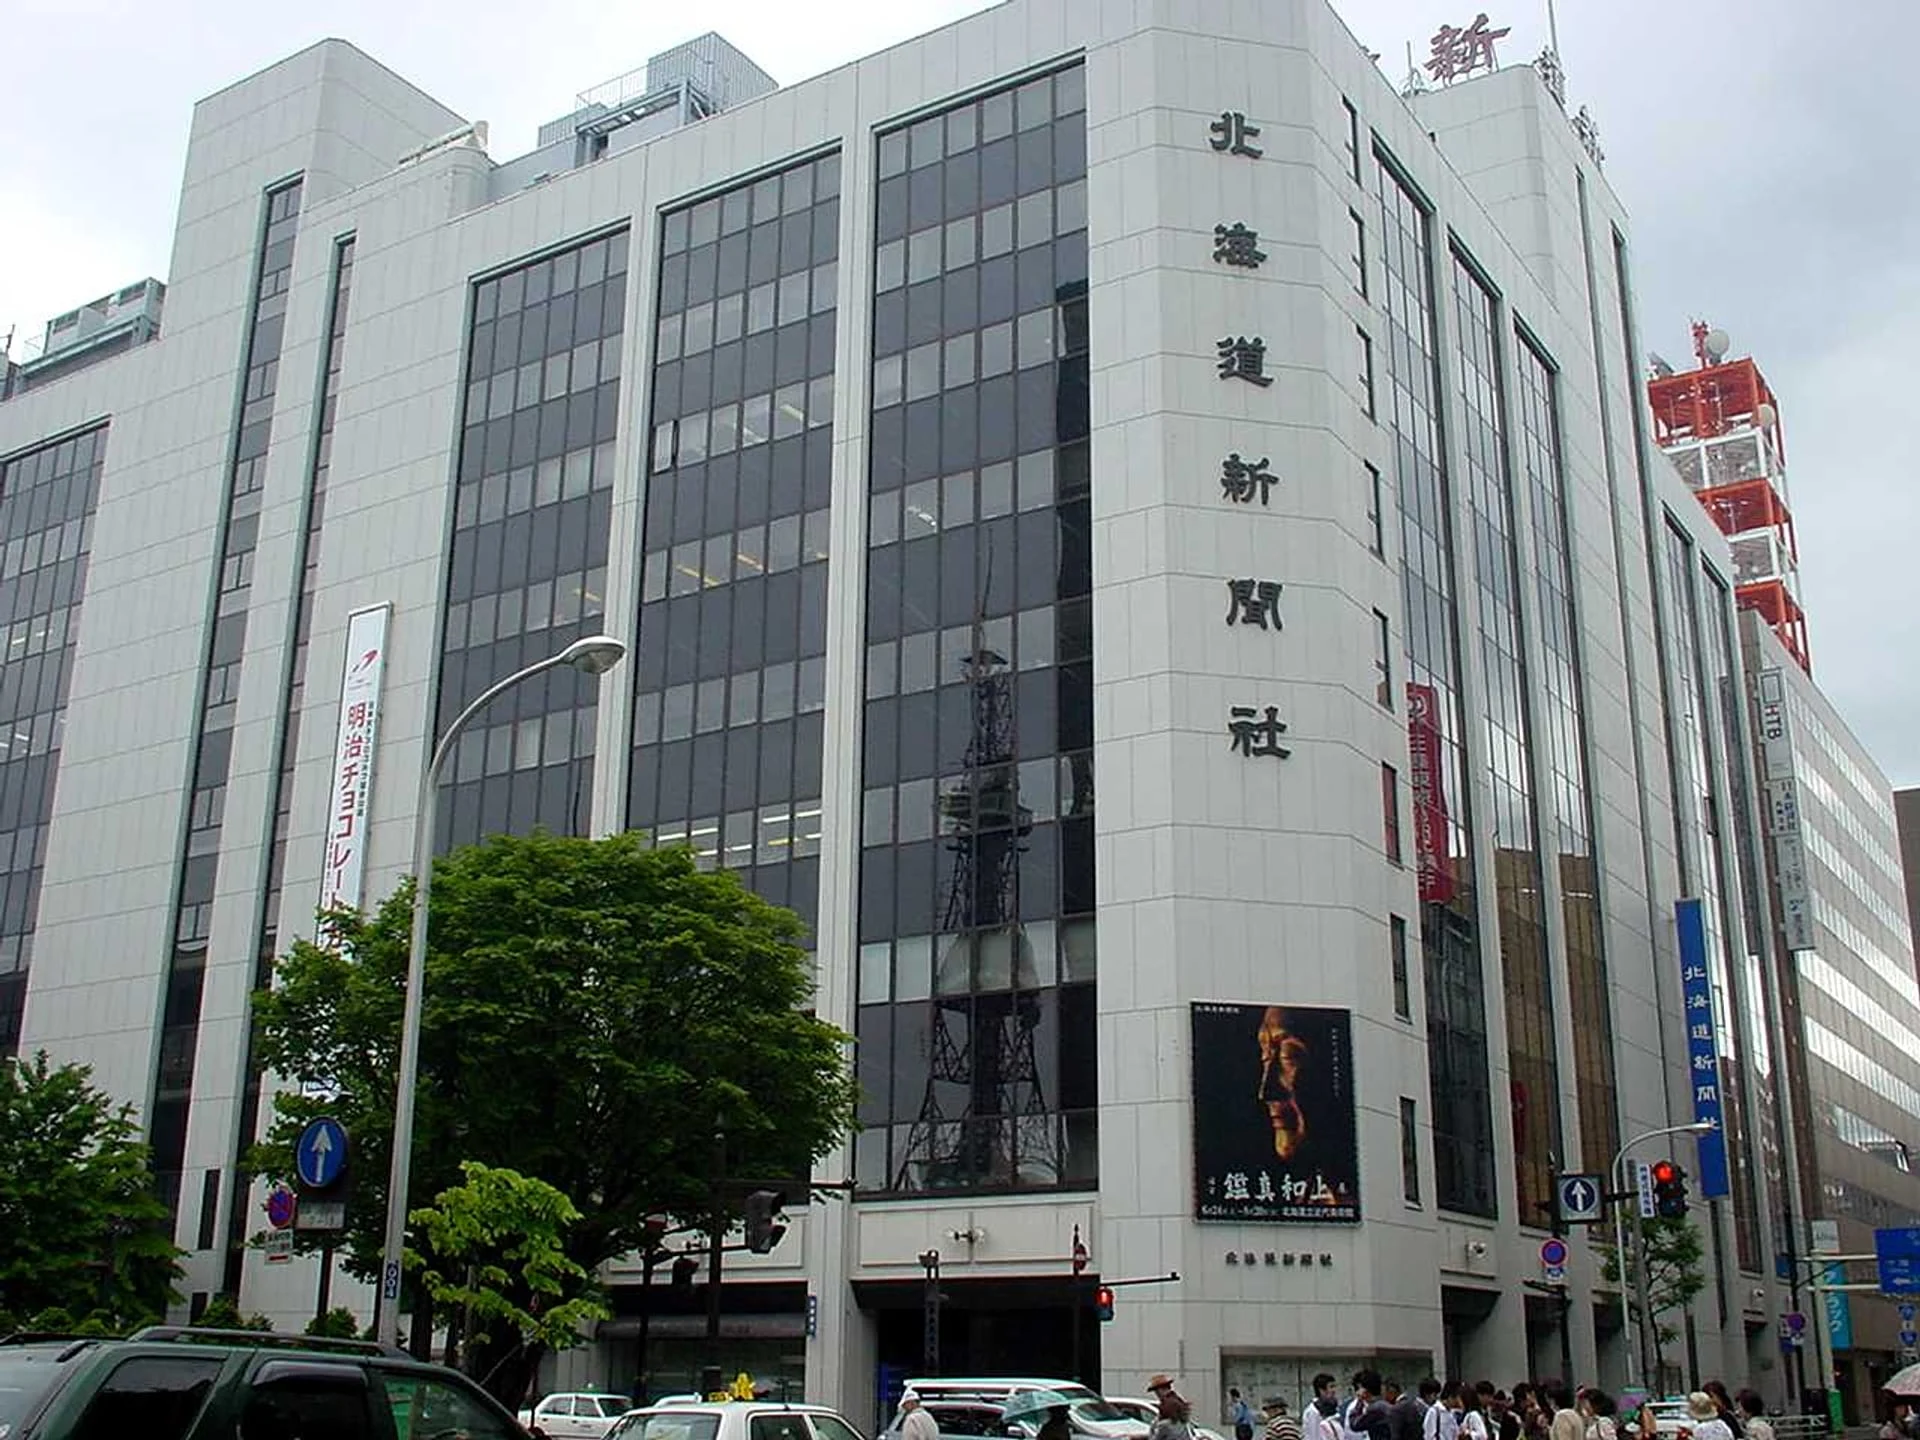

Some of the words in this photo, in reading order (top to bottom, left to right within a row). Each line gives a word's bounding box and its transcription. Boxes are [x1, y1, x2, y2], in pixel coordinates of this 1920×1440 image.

[1424, 13, 1511, 81] 新
[1209, 111, 1291, 759] 北海道新聞社
[1764, 703, 1782, 740] HTB
[1223, 1170, 1334, 1202] 鑑真和上
